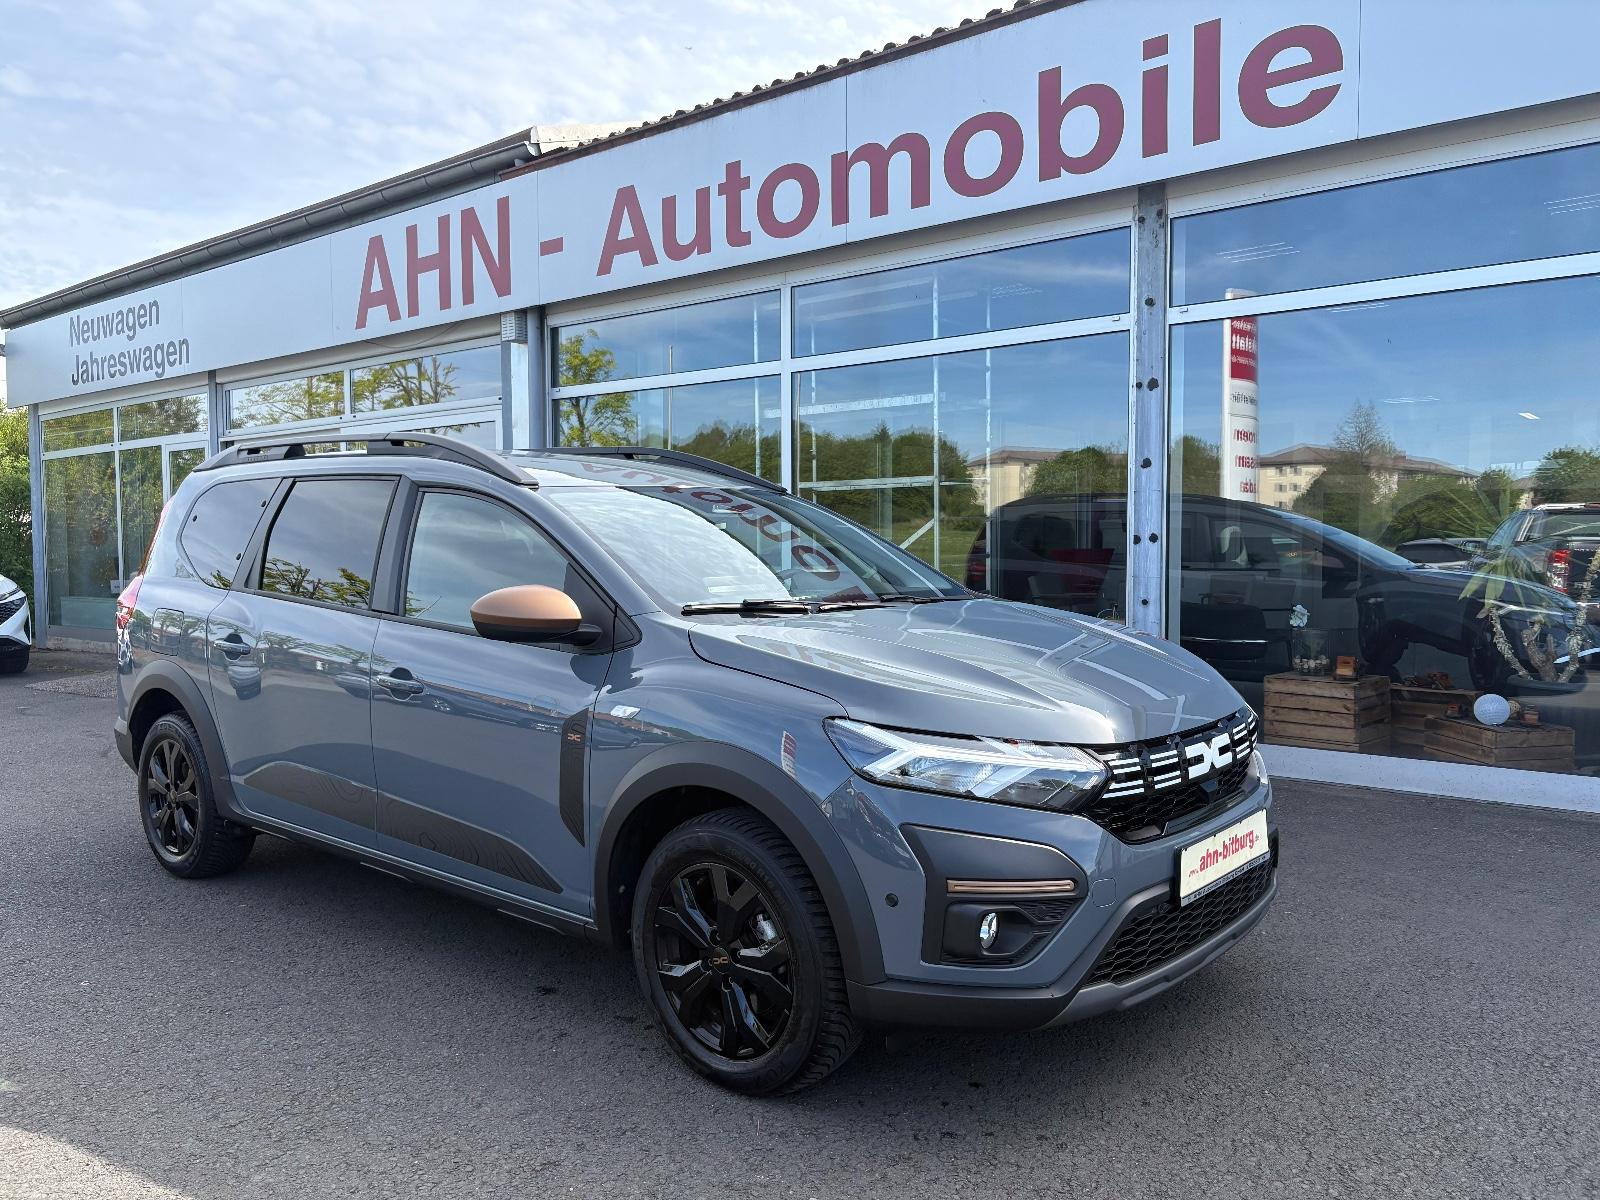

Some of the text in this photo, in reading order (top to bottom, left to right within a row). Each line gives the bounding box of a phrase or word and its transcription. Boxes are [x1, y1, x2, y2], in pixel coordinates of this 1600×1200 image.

[355, 195, 512, 330] AHN
[596, 18, 1344, 276] Automobile
[69, 299, 160, 347] Neuwagen
[71, 338, 190, 386] Jahreswagen
